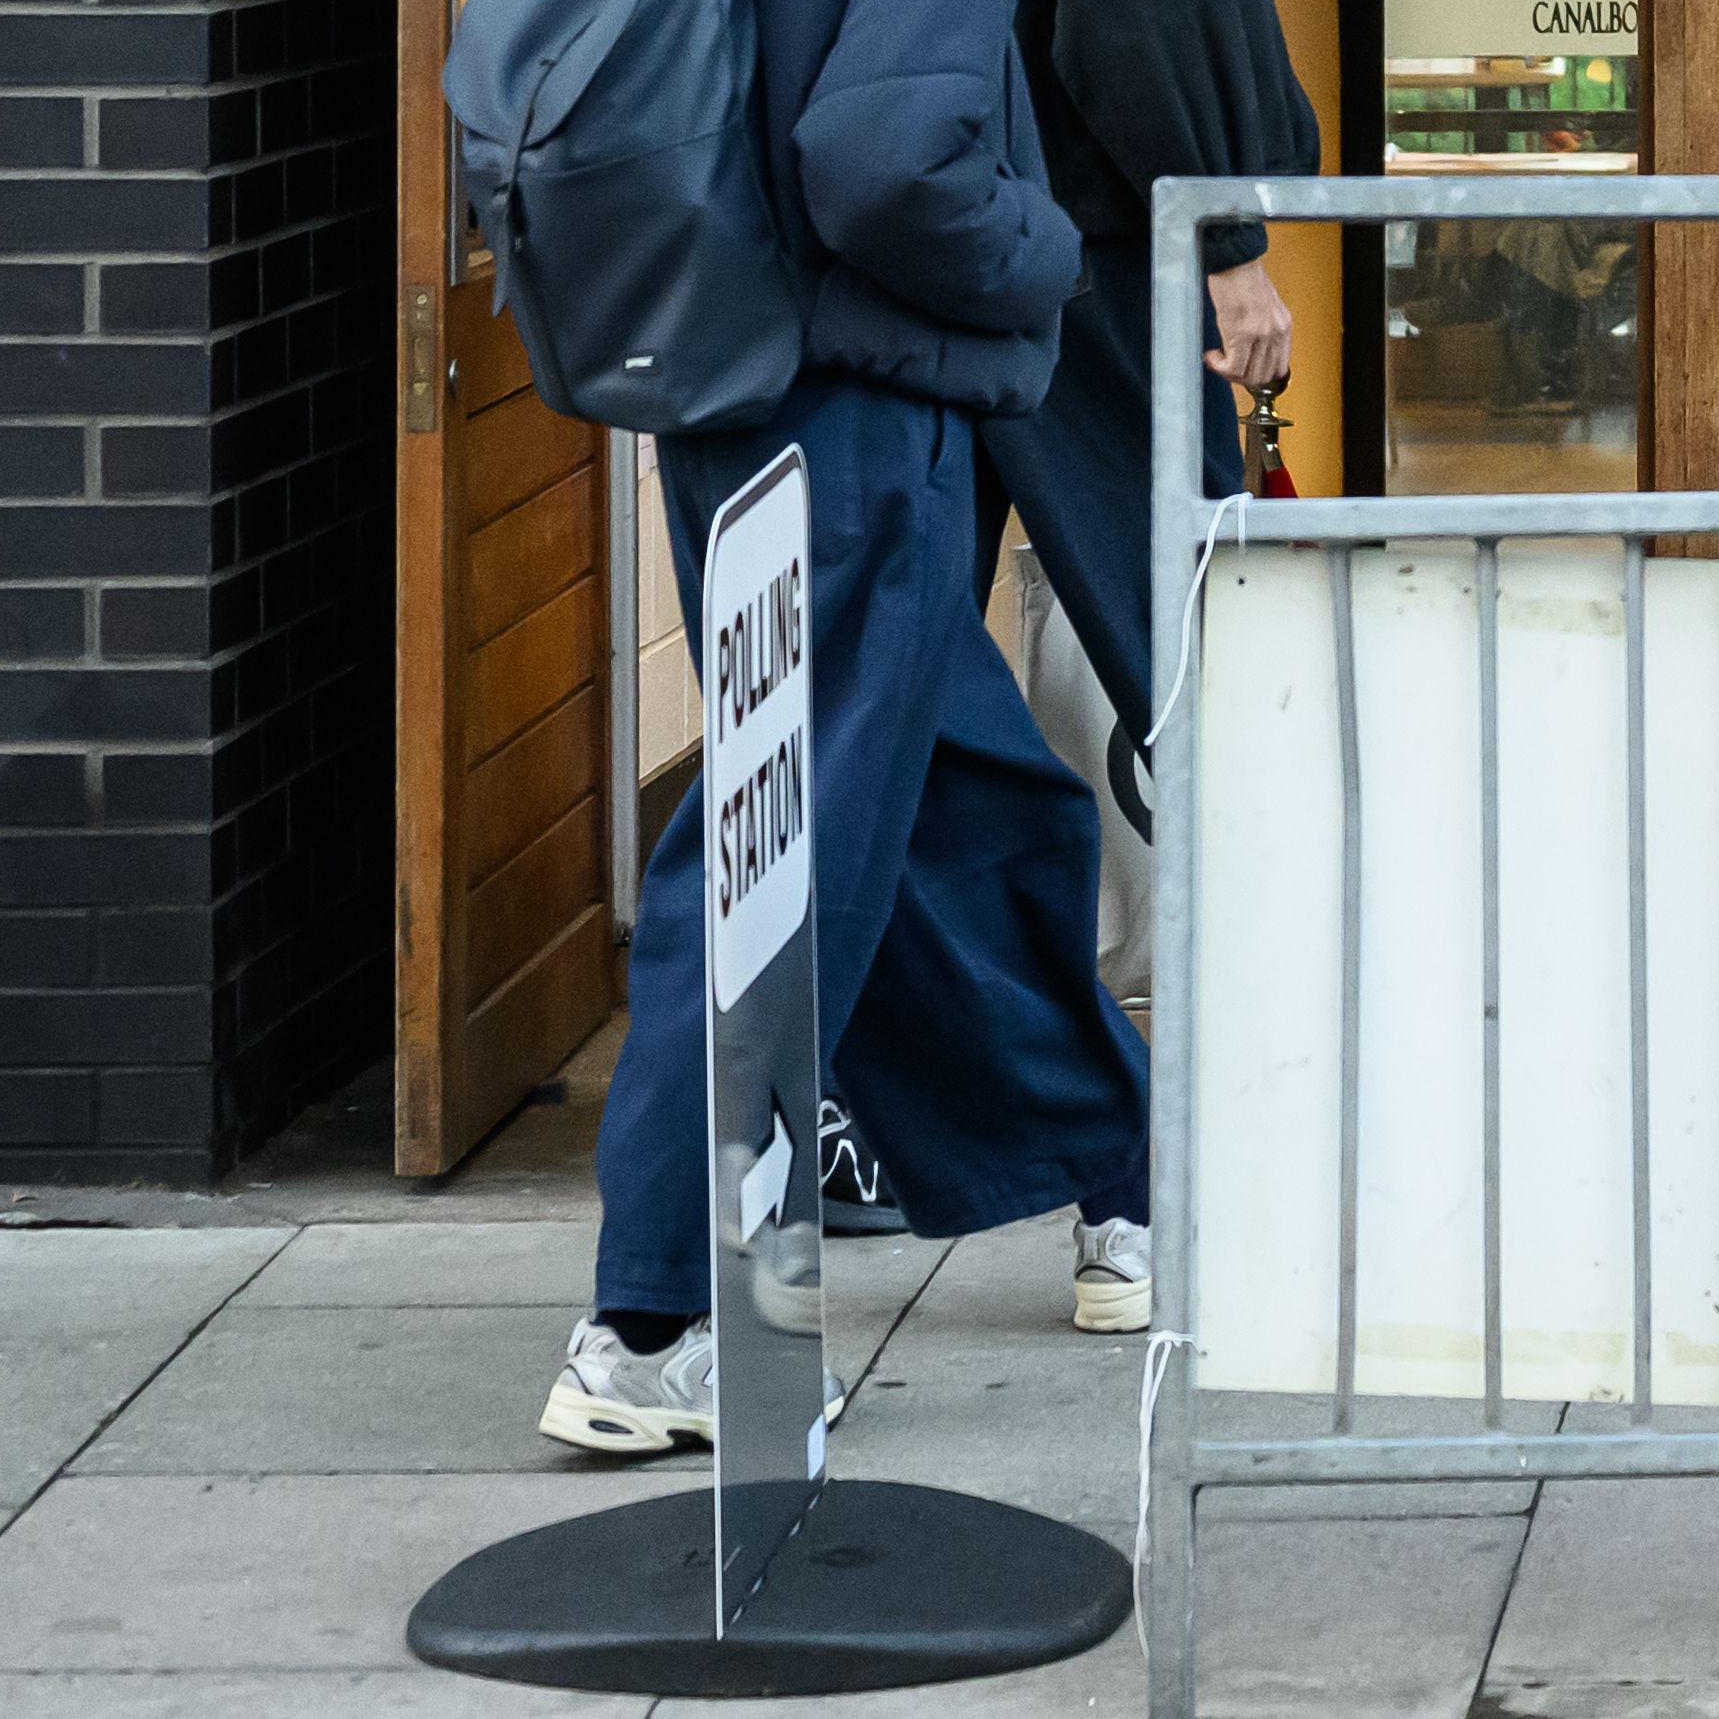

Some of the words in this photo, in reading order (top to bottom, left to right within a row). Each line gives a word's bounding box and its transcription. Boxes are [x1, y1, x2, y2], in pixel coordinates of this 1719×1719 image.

[1532, 1, 1638, 35] CANALBO
[718, 558, 800, 744] POLLING
[719, 725, 803, 919] STATION
